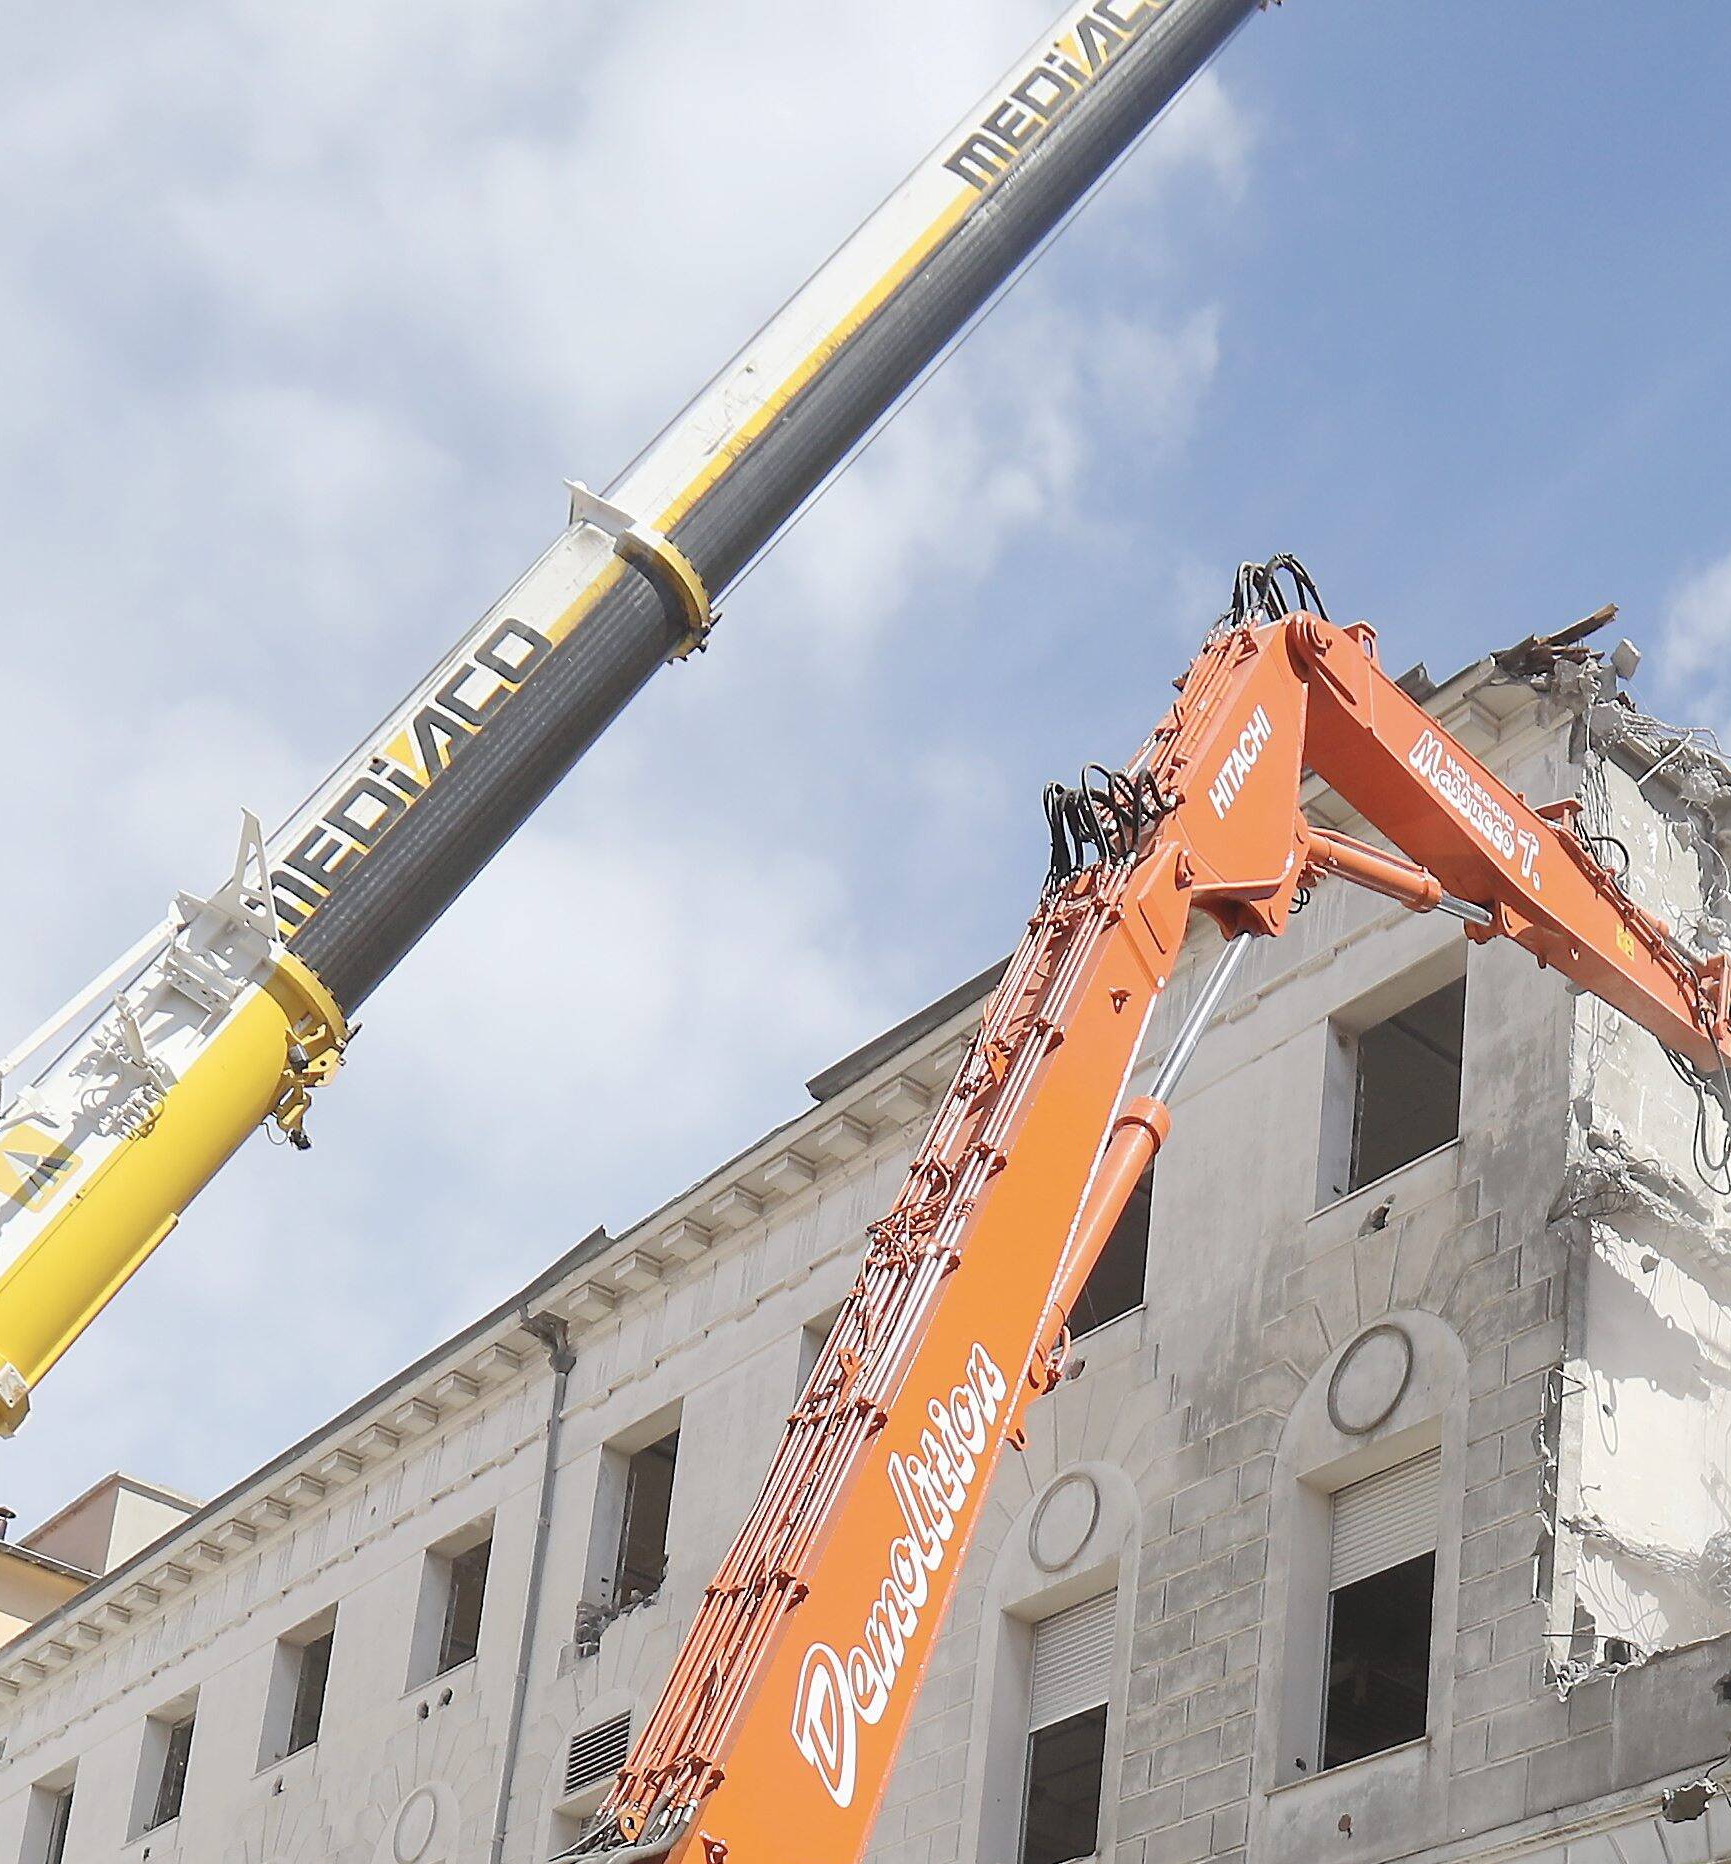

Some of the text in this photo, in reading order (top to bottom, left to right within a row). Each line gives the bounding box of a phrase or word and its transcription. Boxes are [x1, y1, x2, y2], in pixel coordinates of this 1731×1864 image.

[1207, 704, 1273, 820] HITACHI
[1409, 728, 1515, 861] Massucco
[1446, 755, 1515, 832] NOLEGGIO
[791, 1340, 1007, 1809] Demolition
